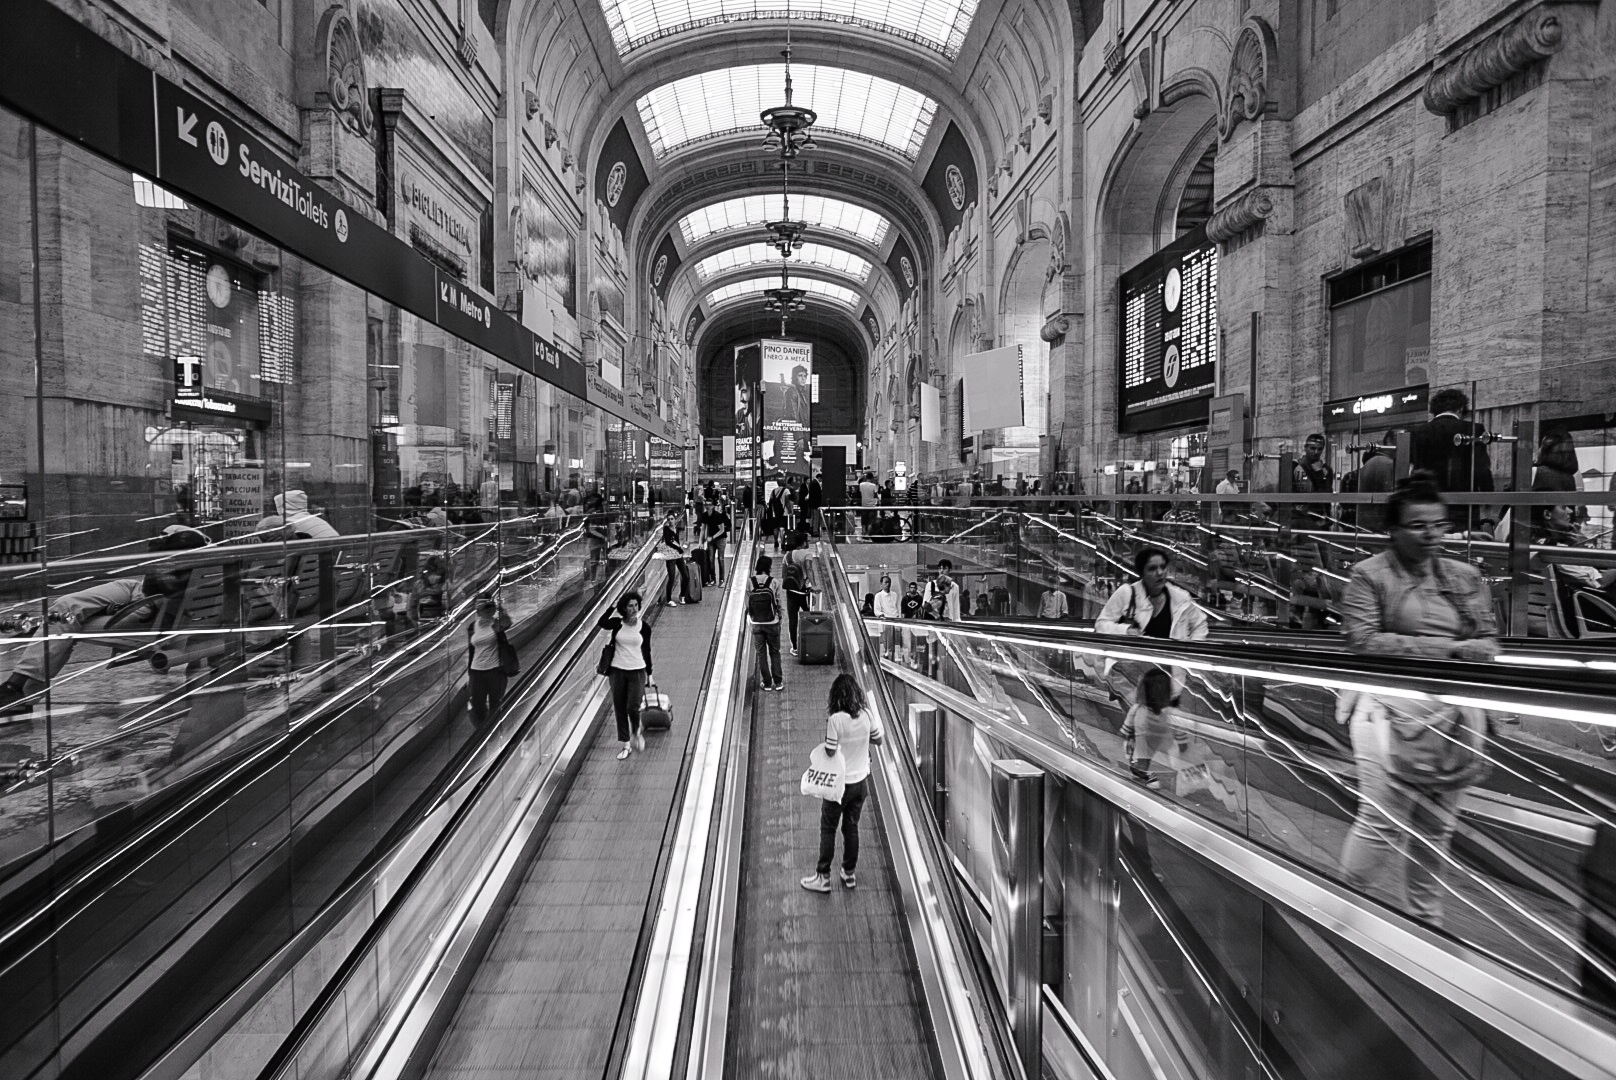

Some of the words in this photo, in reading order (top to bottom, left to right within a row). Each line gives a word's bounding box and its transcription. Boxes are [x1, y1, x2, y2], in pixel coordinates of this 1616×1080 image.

[460, 292, 482, 322] Metro
[545, 346, 555, 365] Taxi
[764, 345, 781, 359] PINO
[783, 347, 810, 362] DANIELE
[177, 356, 199, 386] T
[225, 473, 260, 481] TABACCHI
